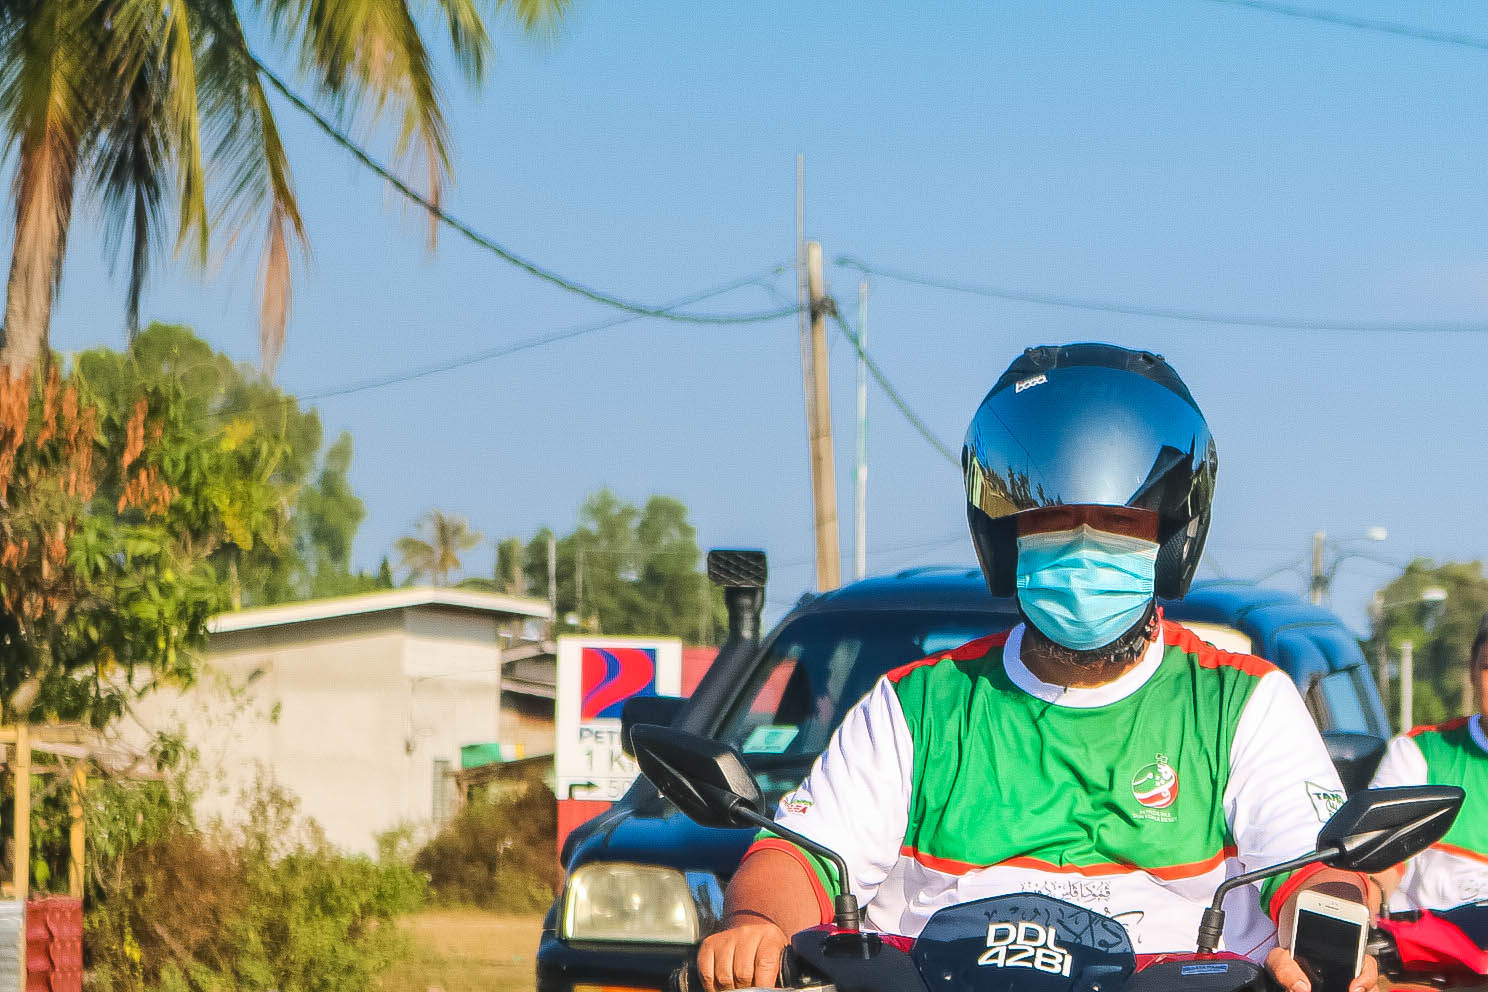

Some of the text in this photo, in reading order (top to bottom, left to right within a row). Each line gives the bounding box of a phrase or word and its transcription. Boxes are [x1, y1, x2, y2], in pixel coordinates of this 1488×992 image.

[578, 726, 621, 744] PET
[986, 921, 1067, 955] DDL
[977, 944, 1073, 978] 4281
